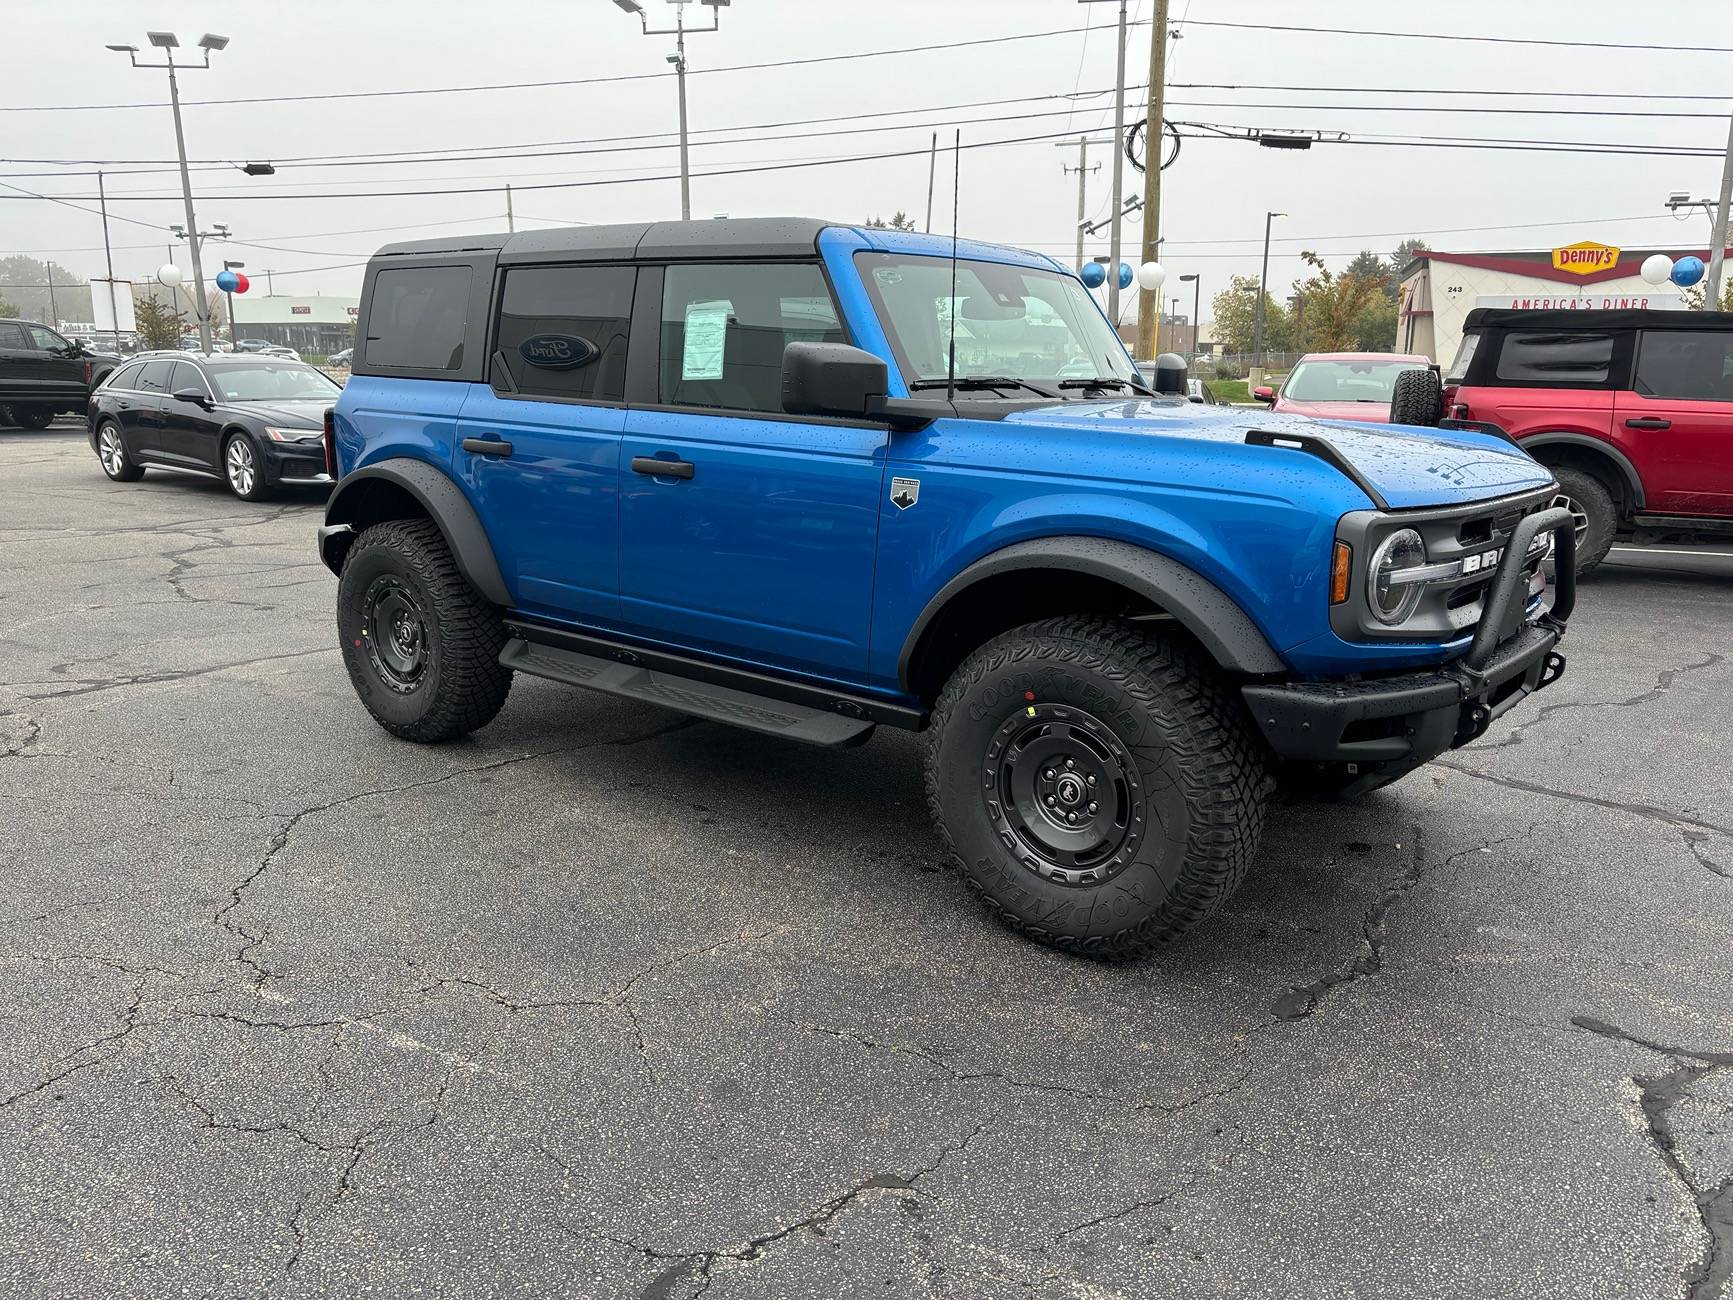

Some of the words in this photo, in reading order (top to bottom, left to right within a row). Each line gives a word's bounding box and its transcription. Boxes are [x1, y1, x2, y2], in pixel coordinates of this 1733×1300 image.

[1560, 248, 1613, 265] Denny's
[1511, 298, 1592, 310] AMERICA'S
[1603, 298, 1649, 310] DINER
